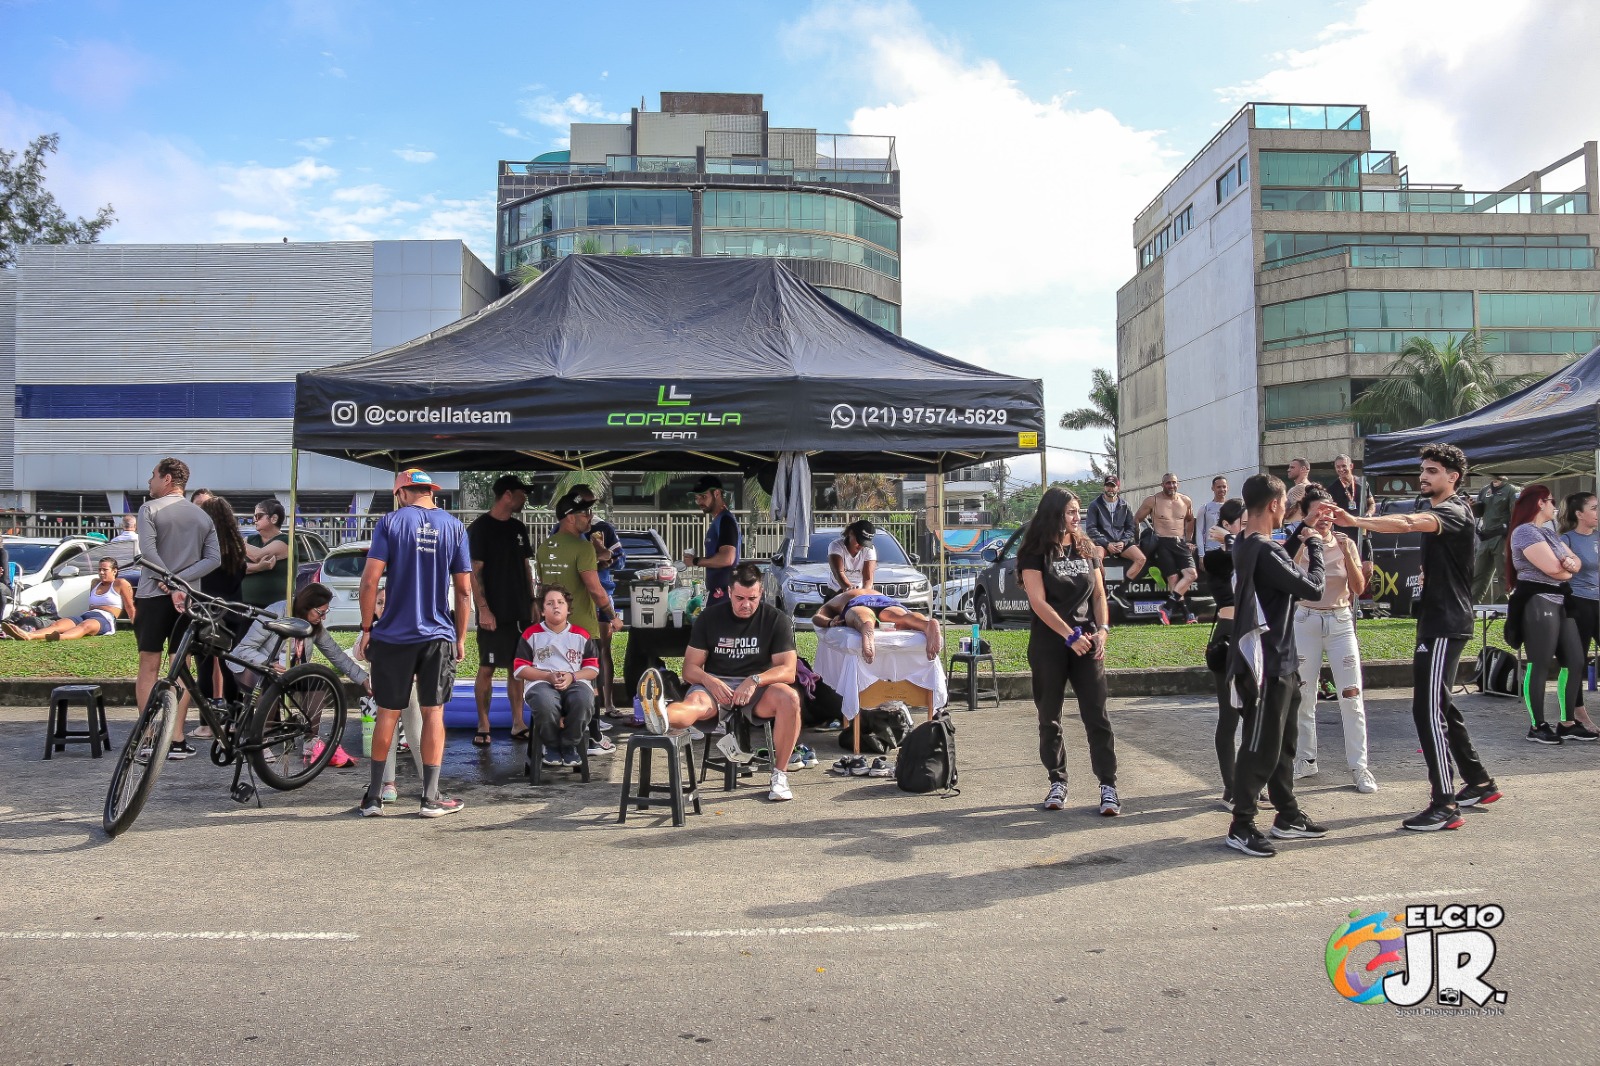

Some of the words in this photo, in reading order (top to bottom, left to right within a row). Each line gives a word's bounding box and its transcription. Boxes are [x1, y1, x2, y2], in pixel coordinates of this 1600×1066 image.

[365, 405, 512, 426] @cordellateam
[861, 406, 897, 427] (21)
[902, 407, 1008, 426] 97574-5629
[651, 431, 698, 440] TEAM
[734, 637, 758, 649] POLO
[714, 646, 736, 655] RALPH
[736, 646, 760, 655] LAUREN
